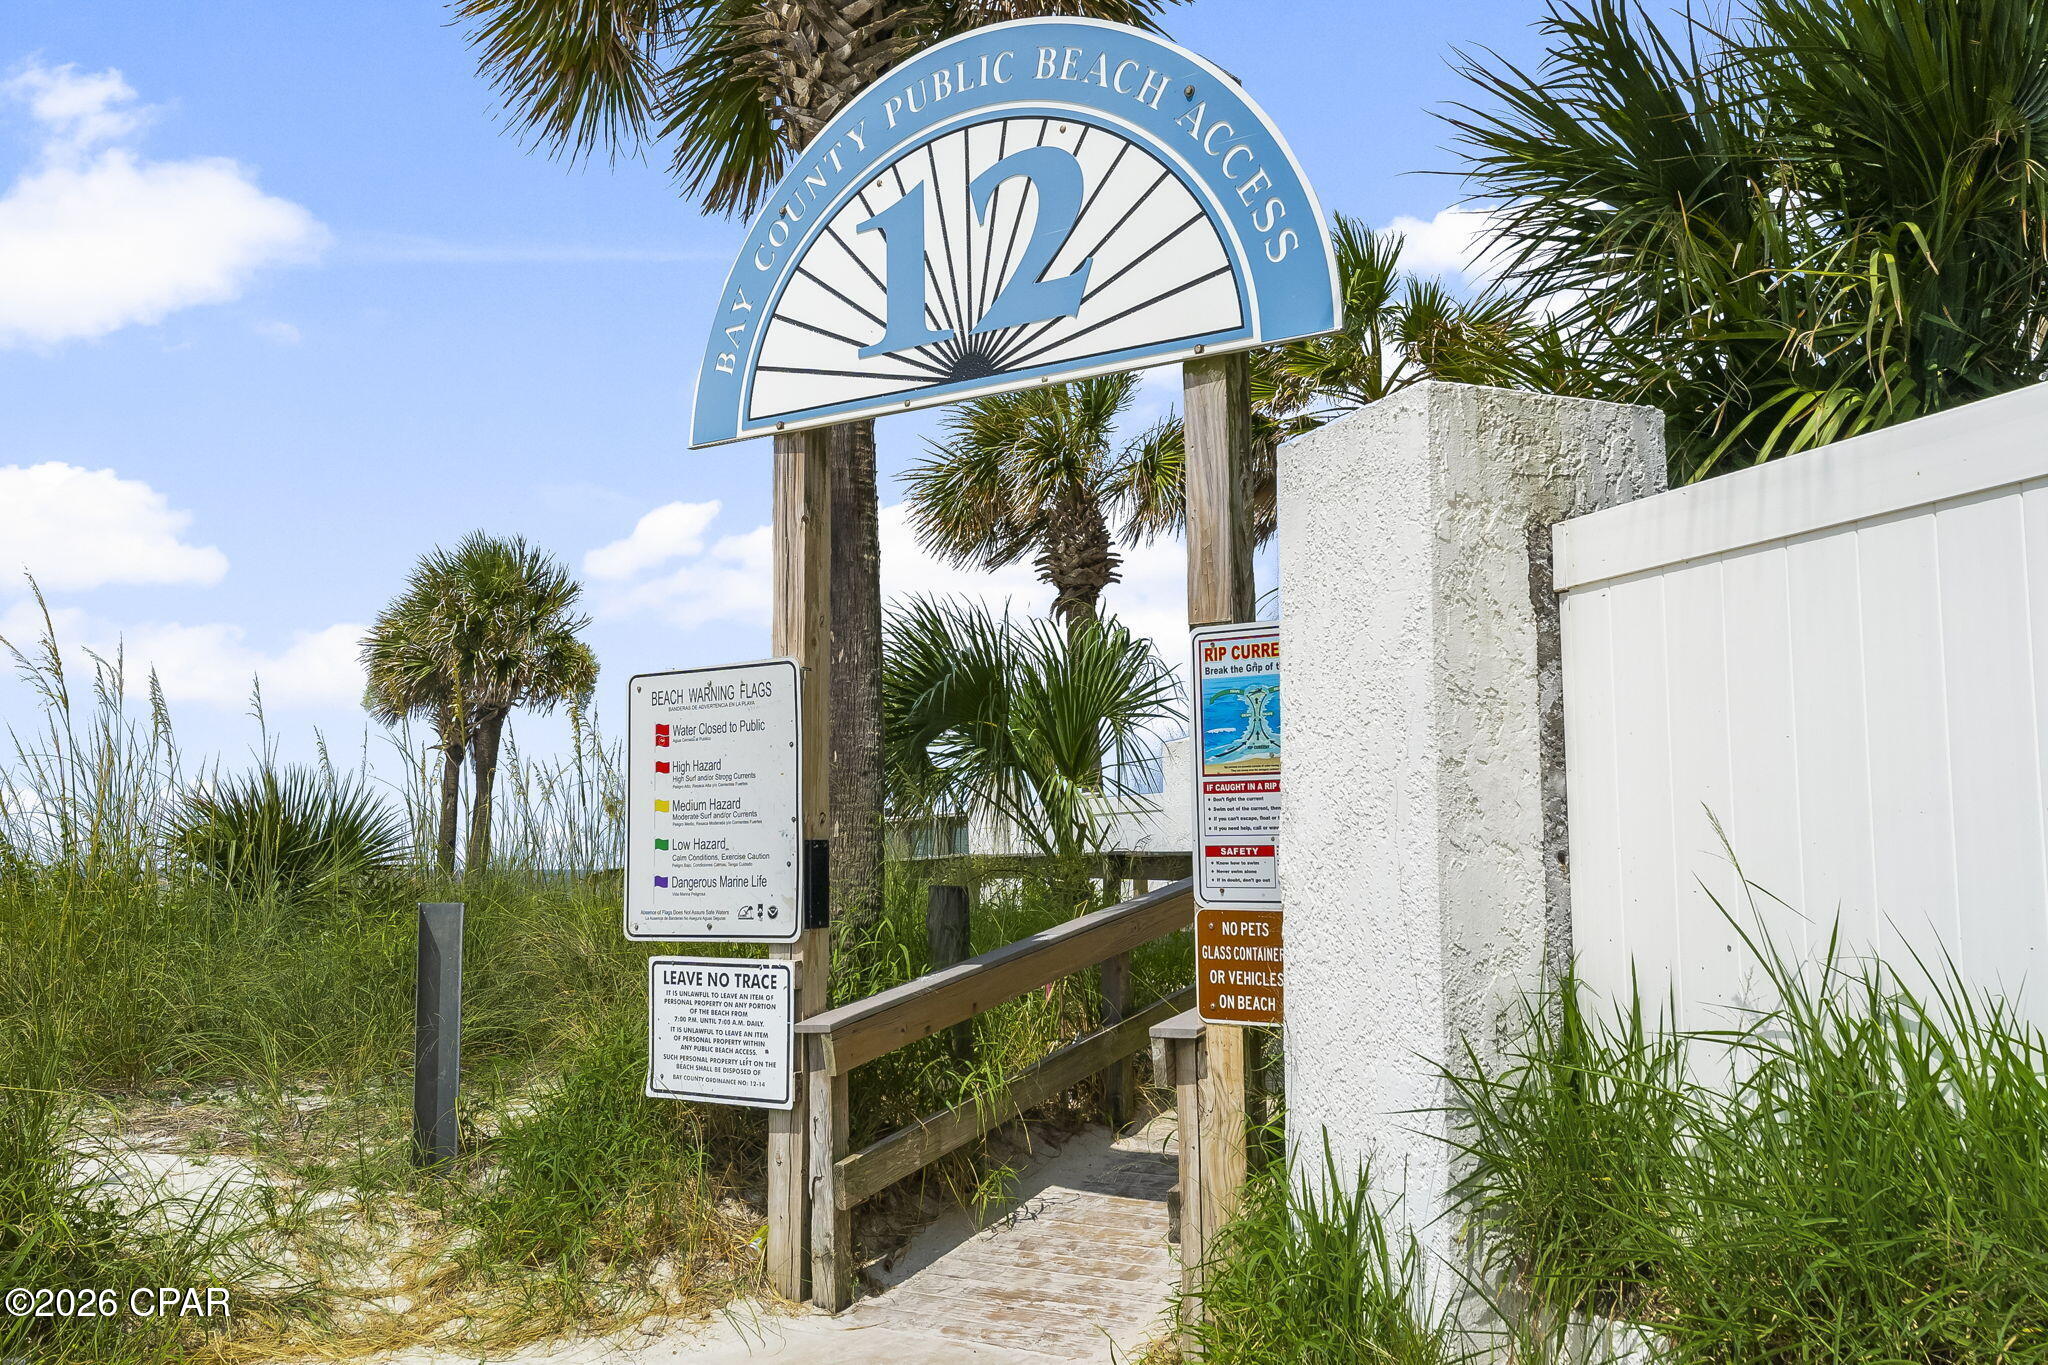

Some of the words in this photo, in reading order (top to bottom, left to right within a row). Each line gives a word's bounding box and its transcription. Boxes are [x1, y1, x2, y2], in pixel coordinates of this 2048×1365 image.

[715, 285, 753, 376] BAY
[753, 120, 868, 272] COUNTY
[885, 51, 1014, 129] PUBLIC
[1034, 46, 1172, 110] BEACH
[1175, 101, 1299, 263] ACCESS
[856, 145, 1093, 359] 12
[1205, 647, 1226, 662] RIP
[1205, 666, 1228, 675] Break
[1231, 665, 1243, 673] the
[1246, 664, 1262, 673] Grip
[1265, 662, 1273, 670] of
[651, 689, 683, 706] BEACH
[689, 685, 734, 703] WARNING
[740, 681, 772, 699] FLAGS
[673, 725, 696, 736] Water
[699, 722, 726, 734] Closed
[729, 722, 737, 732] to
[740, 719, 765, 732] Public
[673, 761, 690, 774] High
[693, 759, 721, 771] Hazard
[673, 799, 706, 811] Medium
[710, 797, 740, 810] Hazard
[672, 840, 690, 850] Low
[694, 839, 725, 849] Hazard
[672, 876, 717, 891] Dangerous
[720, 876, 748, 887] Marine
[752, 875, 767, 887] Life
[1222, 922, 1237, 935] NO
[1241, 922, 1269, 936] PETS
[1202, 945, 1231, 960] GLASS
[663, 971, 702, 985] LEAVE
[708, 972, 729, 987] NO
[735, 974, 777, 989] TRACE
[1210, 970, 1225, 984] OR
[1228, 971, 1284, 986] VEHICLES
[1220, 995, 1234, 1009] ON
[1238, 995, 1275, 1011] BEACH
[723, 1067, 751, 1075] DISPOSED
[705, 1077, 736, 1085] ORDINANCE
